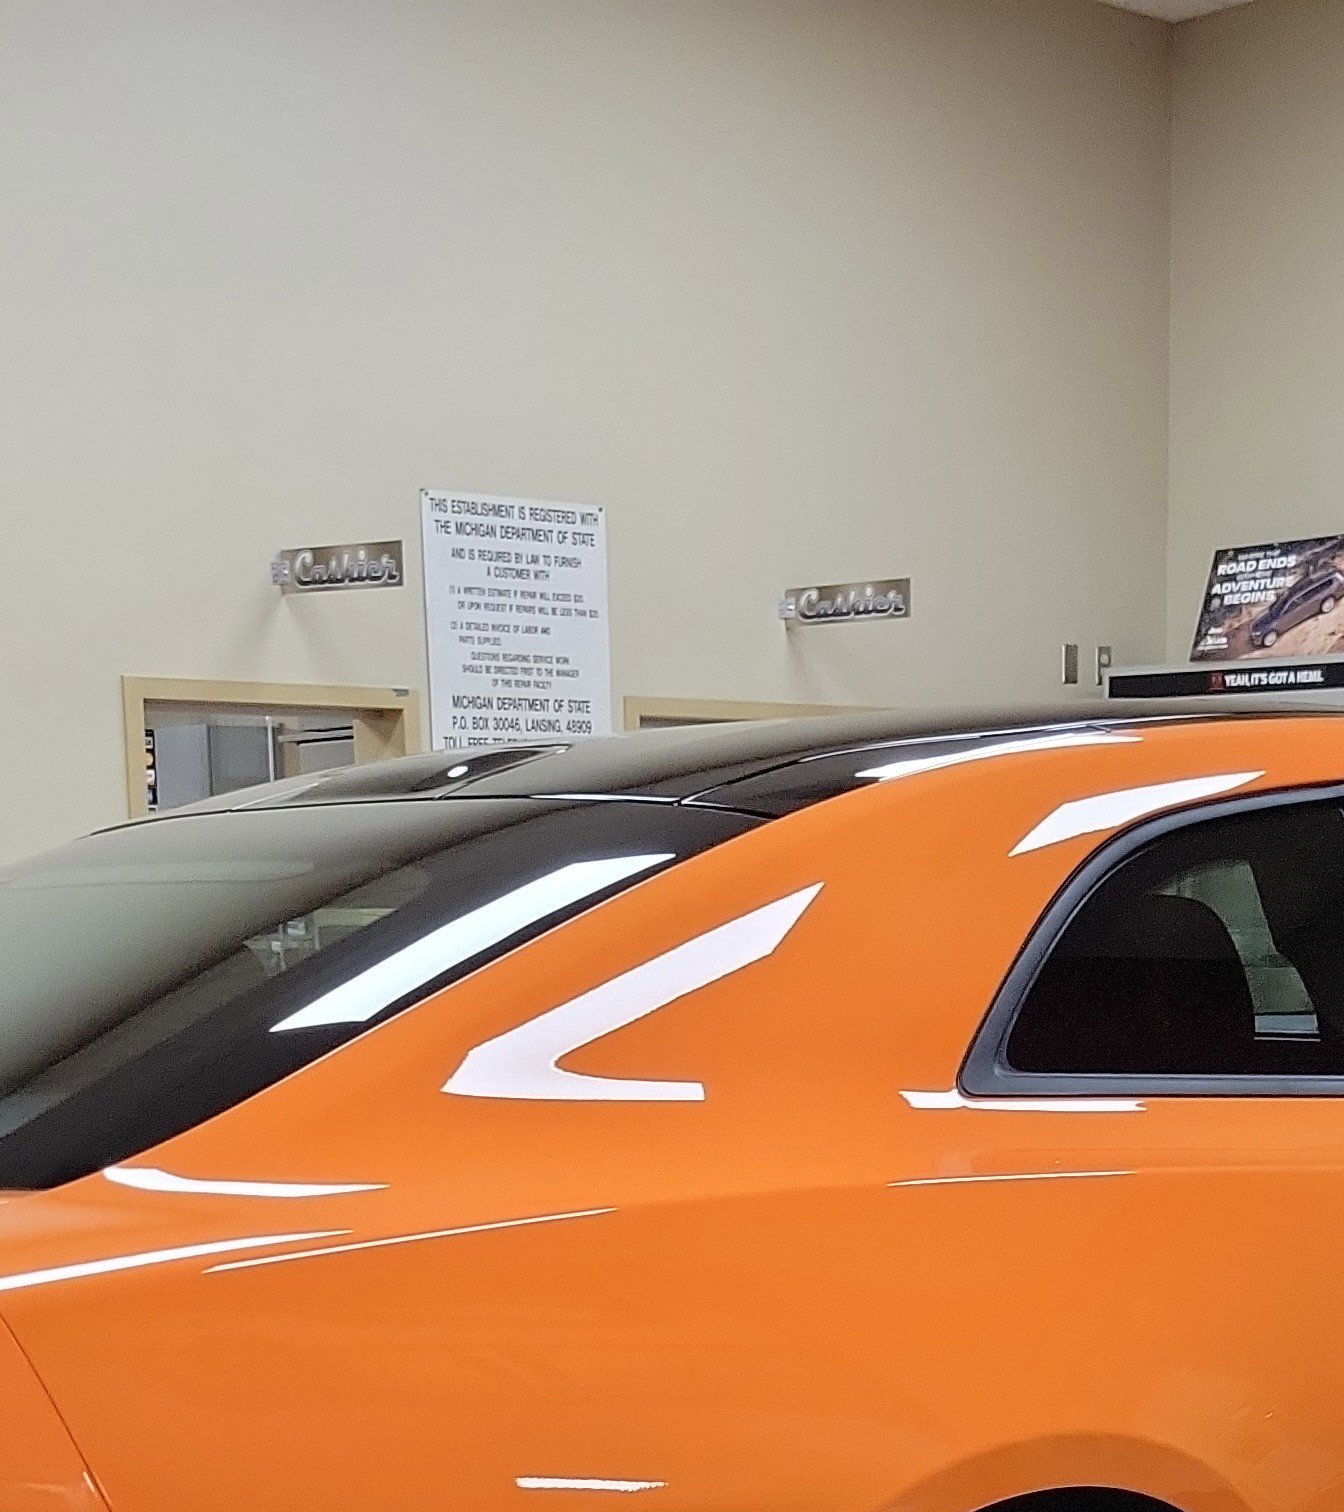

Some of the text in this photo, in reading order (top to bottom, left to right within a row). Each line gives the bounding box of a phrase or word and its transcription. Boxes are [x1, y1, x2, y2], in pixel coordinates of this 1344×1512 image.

[429, 498, 598, 527] THIS ESTABLISHMENT IS REGISTERED WITH
[434, 520, 595, 547] THE MICHIGAN DEPARTMENT OF STATE
[452, 548, 581, 568] AND IS REQUIRED BY LAW TO FURNISH
[1217, 560, 1257, 576] ROAD
[1258, 555, 1297, 570] ENDS
[487, 567, 549, 580] A CUSTOMER WITH
[1211, 575, 1295, 594] ADVENTURE
[1223, 590, 1276, 605] BEGINS
[1268, 671, 1288, 685] GOT
[1288, 671, 1296, 684] A
[452, 695, 591, 714] MICHIGAN DEPARTMENT OF STATE
[452, 716, 468, 730] P.O.
[472, 717, 489, 730] BOX
[566, 720, 592, 734] 48909
